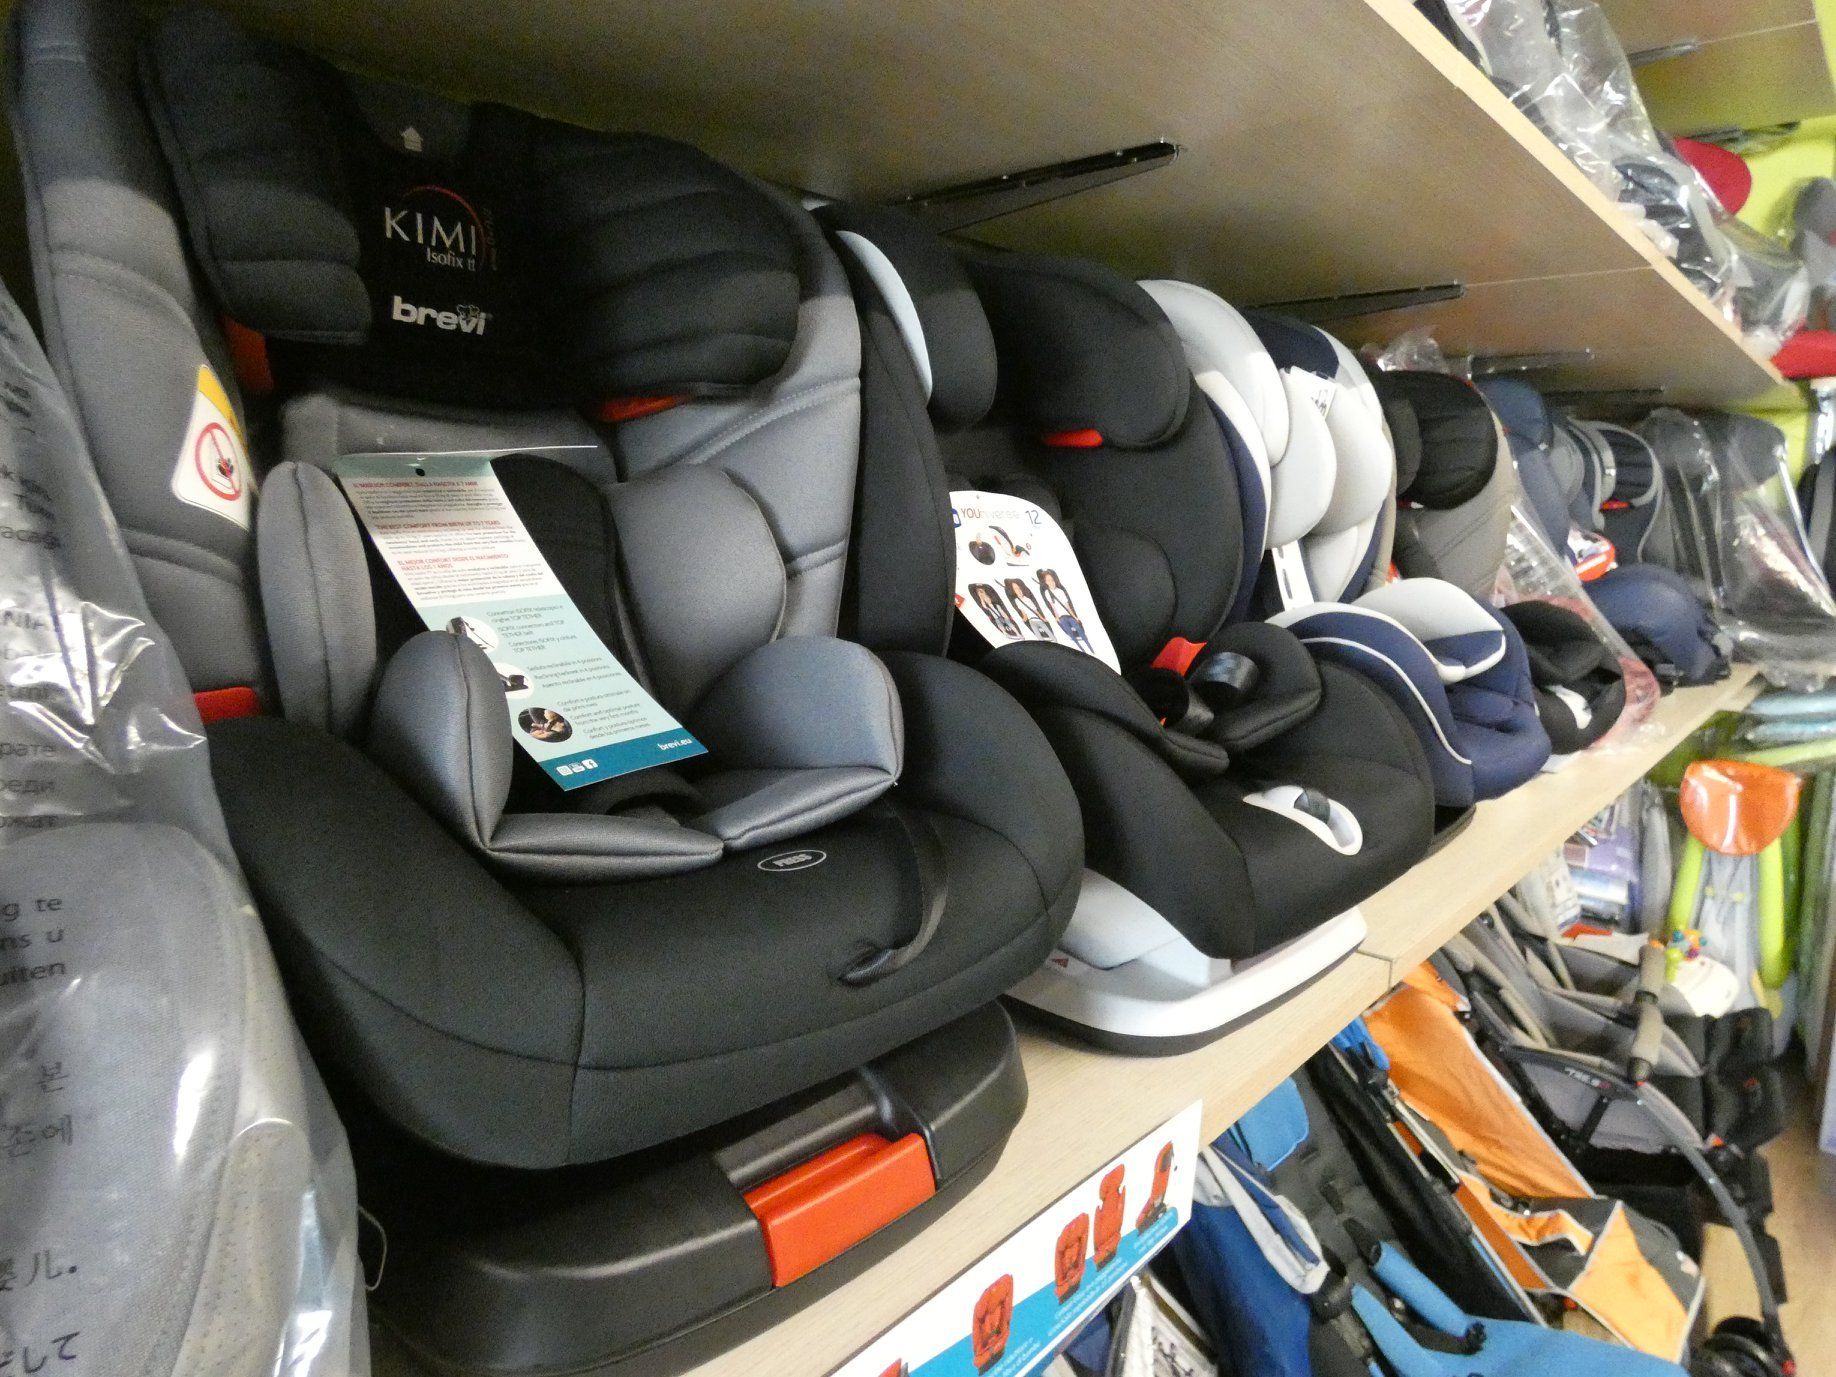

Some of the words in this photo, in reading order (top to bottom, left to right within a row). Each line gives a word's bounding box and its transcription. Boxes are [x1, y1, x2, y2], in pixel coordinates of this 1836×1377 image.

[384, 206, 477, 256] KIMI
[426, 247, 463, 269] Isofix
[392, 295, 488, 336] brevi
[1025, 509, 1042, 525] 12
[657, 738, 693, 751] brevi.eu
